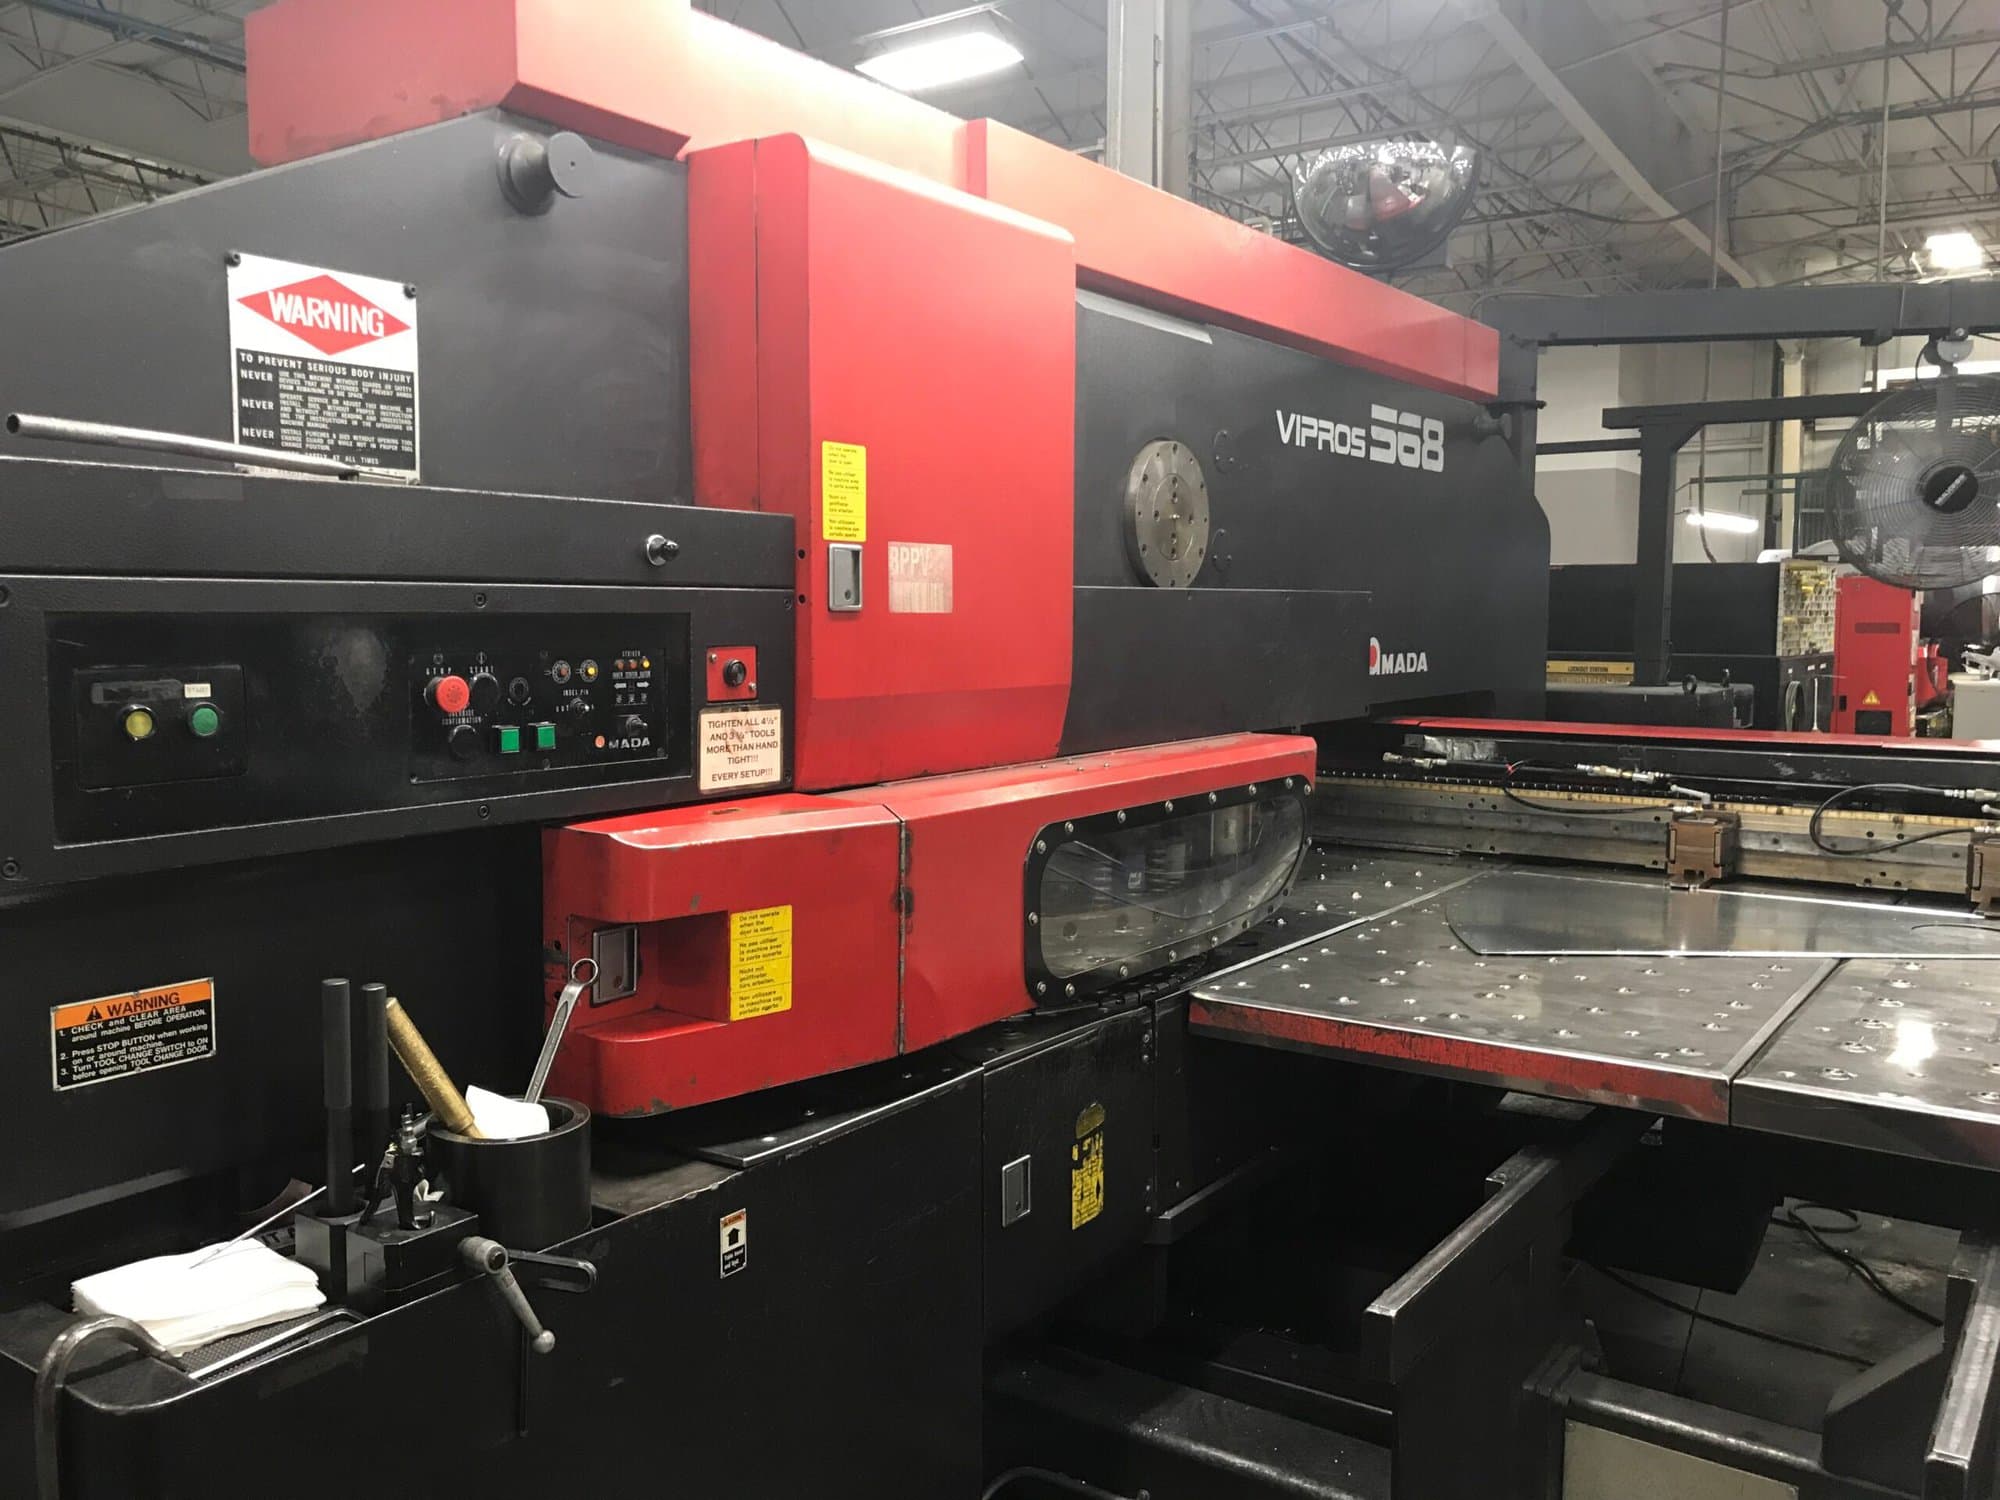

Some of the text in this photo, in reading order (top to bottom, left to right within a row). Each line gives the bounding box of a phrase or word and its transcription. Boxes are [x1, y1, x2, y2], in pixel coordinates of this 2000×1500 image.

[267, 290, 385, 337] WARNING
[240, 352, 411, 384] TO PREVENT SERIOUS BODY INJURY
[240, 369, 273, 382] NEVER
[241, 398, 274, 410] NEVER
[242, 427, 274, 439] NEVER
[1276, 403, 1444, 472] VIPROS 568
[708, 719, 743, 729] TIGHTEN
[744, 717, 760, 726] ALL
[710, 732, 728, 741] AND
[750, 729, 776, 738] TOOLS
[706, 741, 778, 754] MORE THAN HAND
[712, 772, 738, 782] EVERY
[107, 992, 180, 1017] WARNING
[72, 1022, 103, 1035] CHECK
[109, 1018, 125, 1027] and
[129, 1010, 159, 1023] CLEAR
[163, 1005, 186, 1016] AREA
[72, 1031, 97, 1042] around
[101, 1025, 131, 1036] machine
[134, 1017, 163, 1030] BEFORE
[72, 1047, 95, 1058] Press
[96, 1041, 120, 1053] STOP
[122, 1034, 155, 1047] BUTTON
[157, 1030, 178, 1039] when
[179, 1024, 208, 1034] working
[72, 1058, 82, 1066] on
[99, 1047, 126, 1060] around
[73, 1064, 92, 1073] Turn
[94, 1058, 117, 1068] TOOL
[119, 1049, 153, 1062] CHANGE
[155, 1042, 186, 1054] SWITCH
[197, 1037, 208, 1045] ON
[73, 1070, 96, 1081] before
[100, 1064, 127, 1075] opening
[153, 1050, 184, 1062] CHANGE
